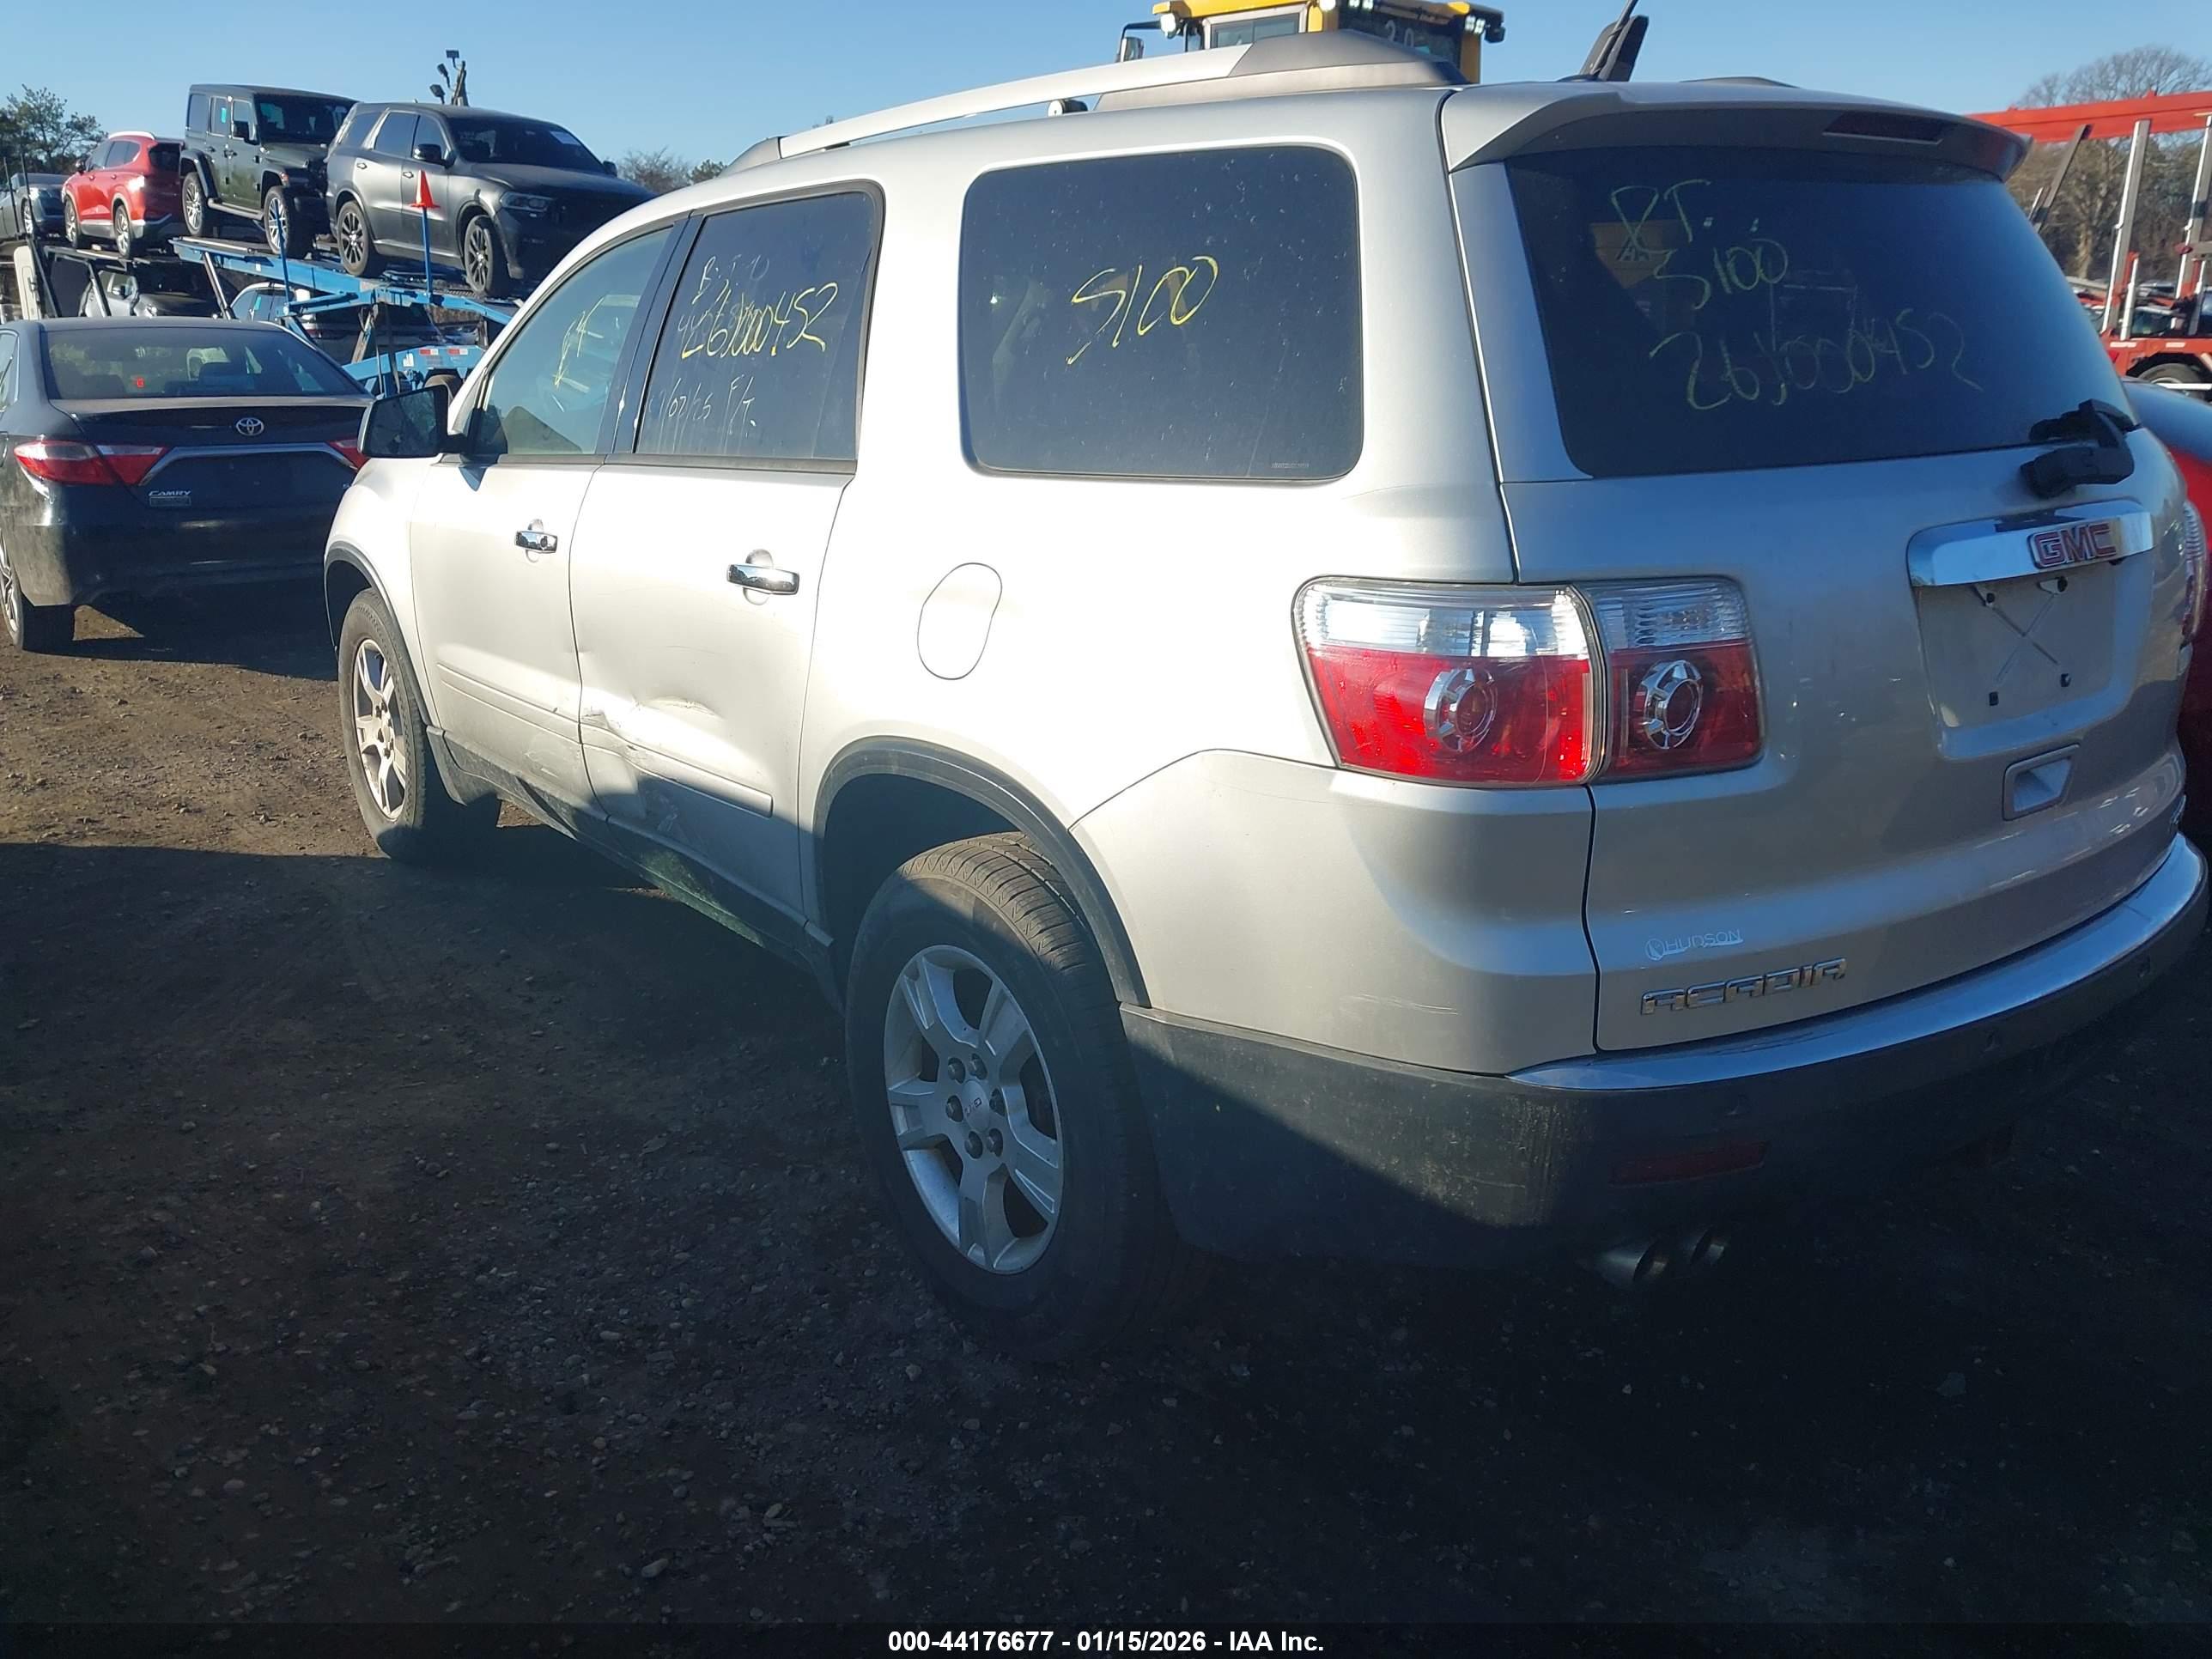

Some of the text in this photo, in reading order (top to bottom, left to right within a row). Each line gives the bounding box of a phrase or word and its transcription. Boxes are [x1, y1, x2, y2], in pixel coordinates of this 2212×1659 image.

[2027, 522, 2116, 569] GMC
[1665, 928, 1743, 951] HUDSON
[1641, 957, 1845, 1015] ACADIA
